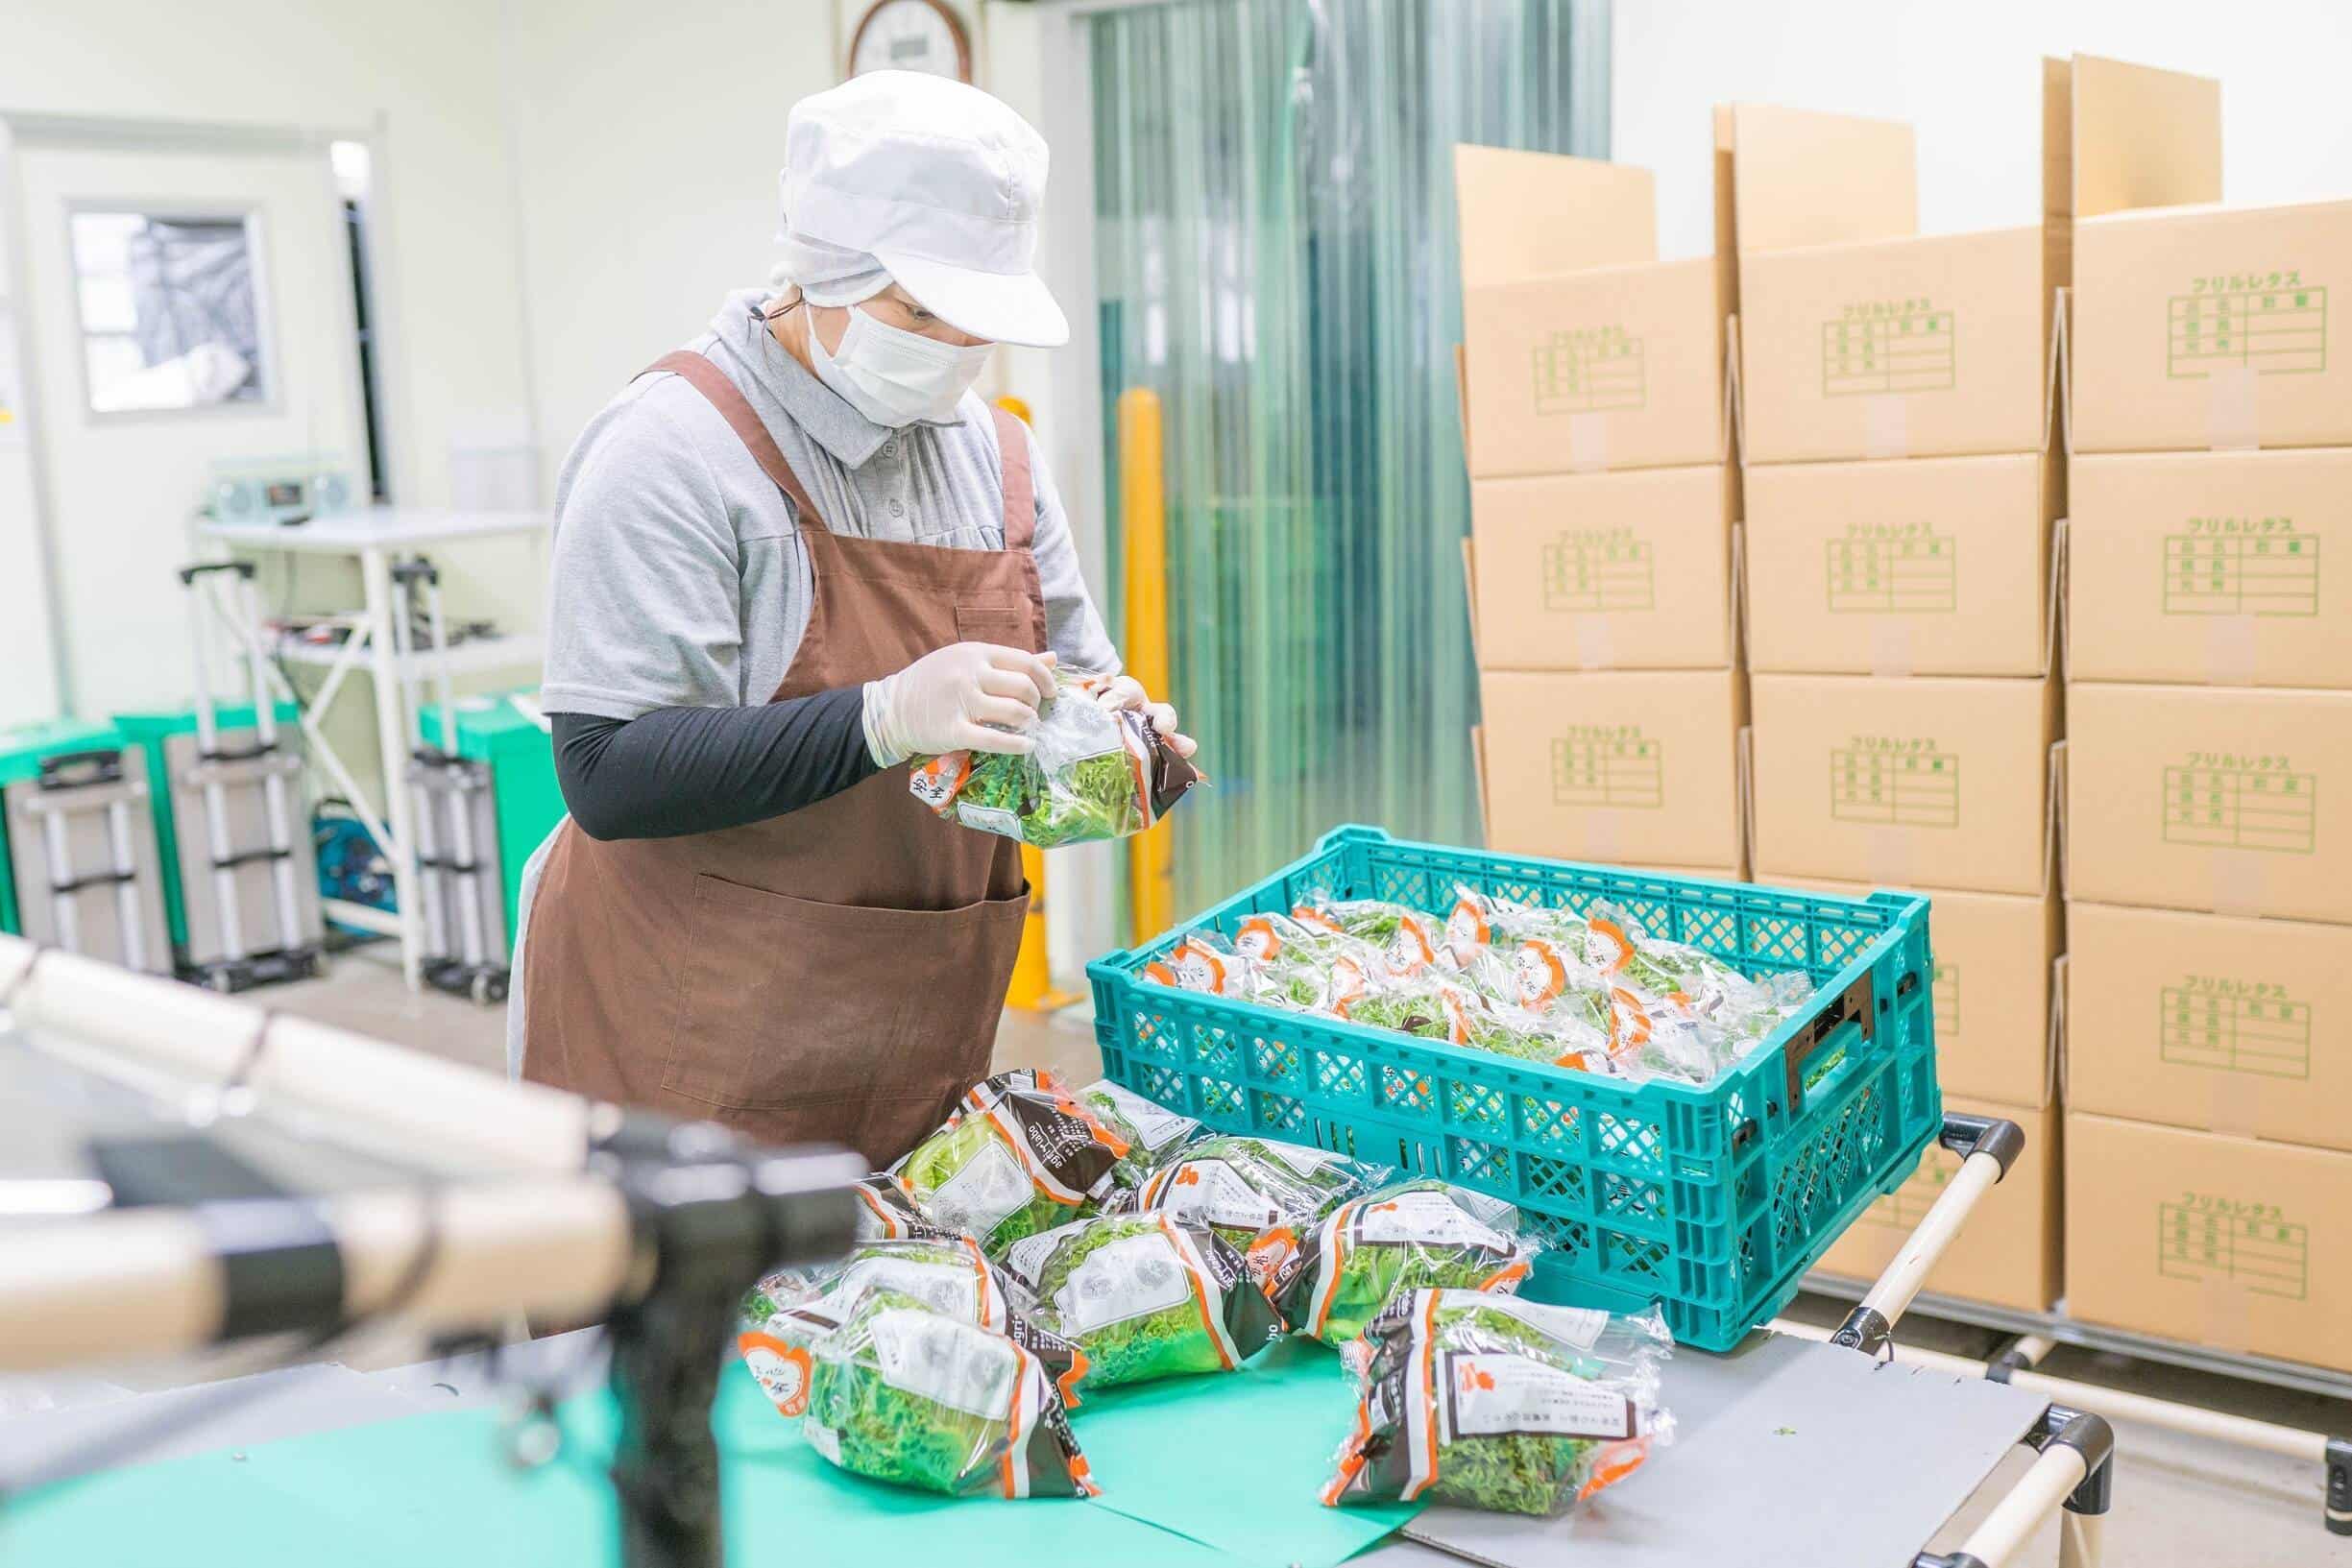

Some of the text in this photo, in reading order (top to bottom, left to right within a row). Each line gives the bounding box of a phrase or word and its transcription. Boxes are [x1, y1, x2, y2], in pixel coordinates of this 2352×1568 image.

[2193, 271, 2301, 292] フリルレタス
[1844, 298, 1931, 318] フリルレタス
[1846, 521, 1933, 539] フリルレタス
[2188, 518, 2295, 533] フリルレタス
[1852, 734, 1936, 752] フリルレタス
[2186, 751, 2291, 770] フリルレタス
[2185, 975, 2289, 999] フリルレタス
[2182, 1190, 2283, 1218] フリルレタス
